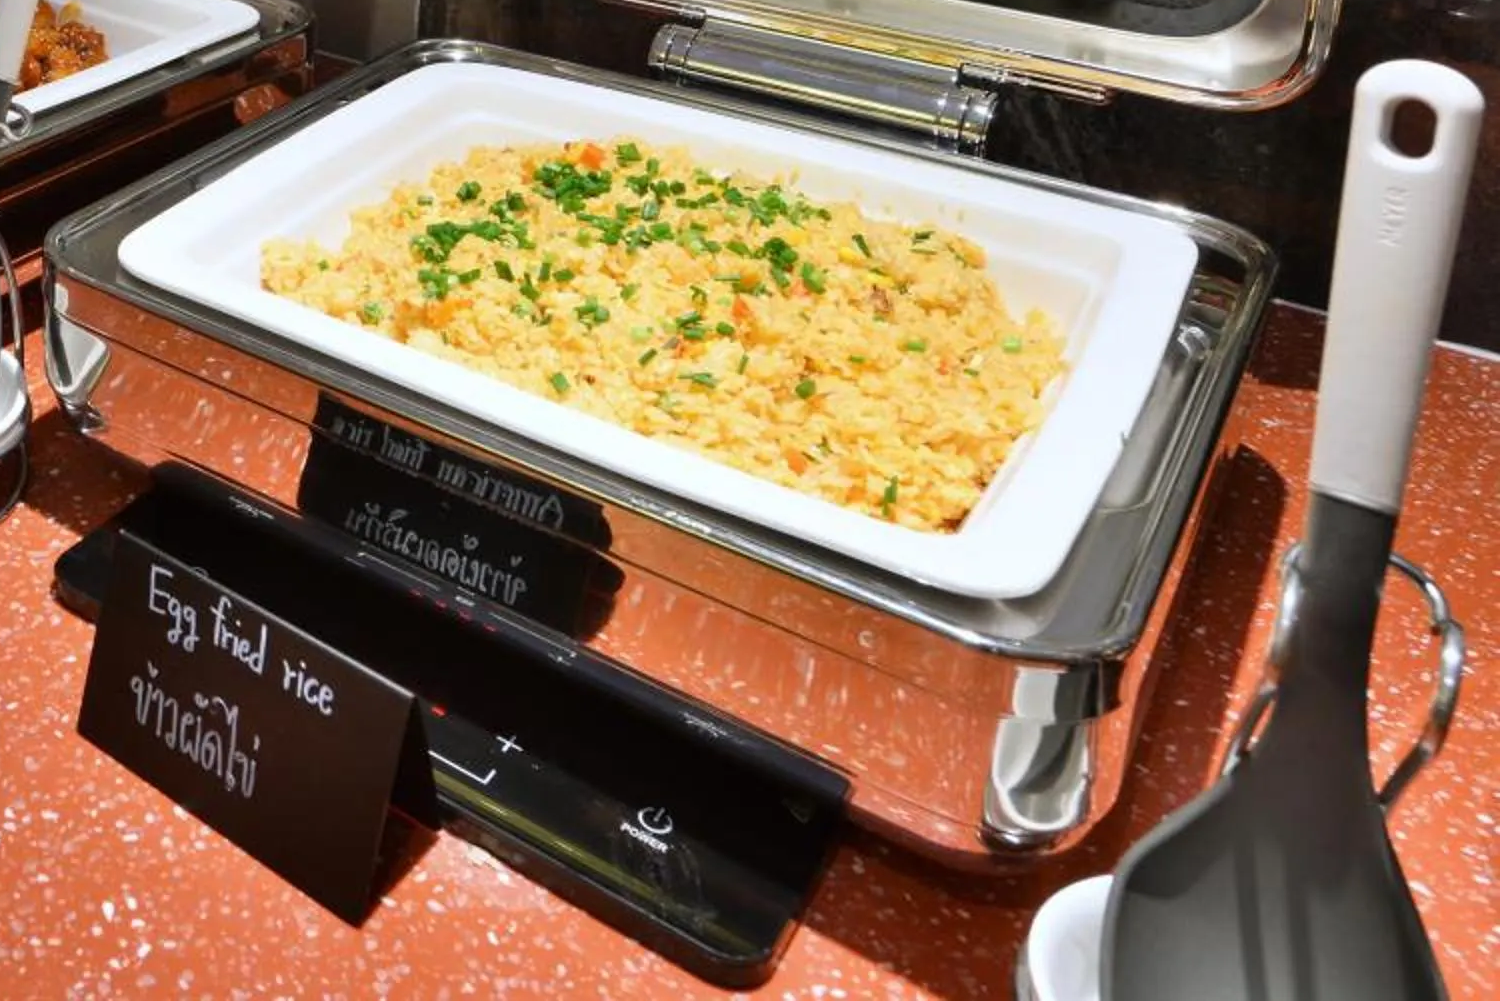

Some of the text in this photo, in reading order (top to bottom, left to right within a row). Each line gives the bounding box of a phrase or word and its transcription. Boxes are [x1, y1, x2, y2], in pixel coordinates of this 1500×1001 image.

[148, 564, 335, 717] Egg fried rice
[130, 660, 261, 798] ข้าวผัดไข่
[619, 821, 669, 853] POWER
